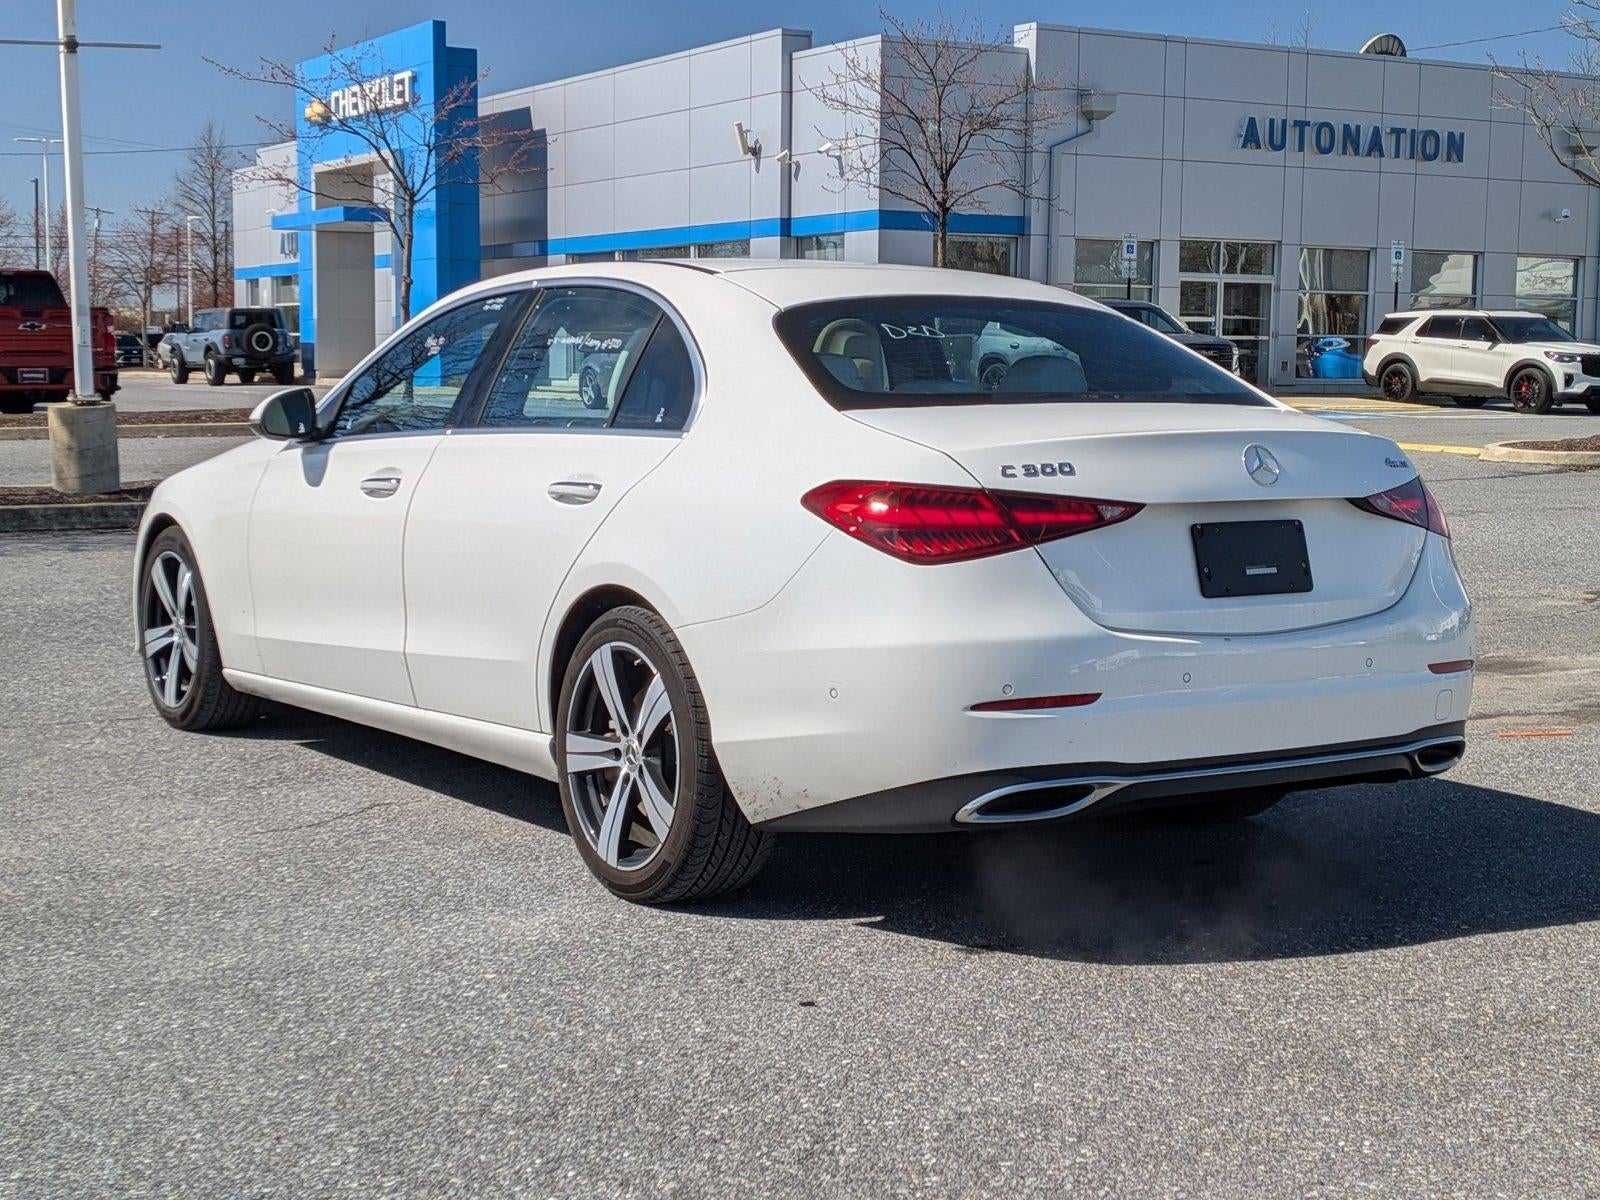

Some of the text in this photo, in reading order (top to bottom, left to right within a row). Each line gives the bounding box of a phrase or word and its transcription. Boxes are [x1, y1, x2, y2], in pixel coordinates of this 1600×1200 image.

[331, 70, 414, 120] CHEVROLET
[1239, 116, 1465, 163] AUTONATION
[1000, 462, 1077, 479] C 300
